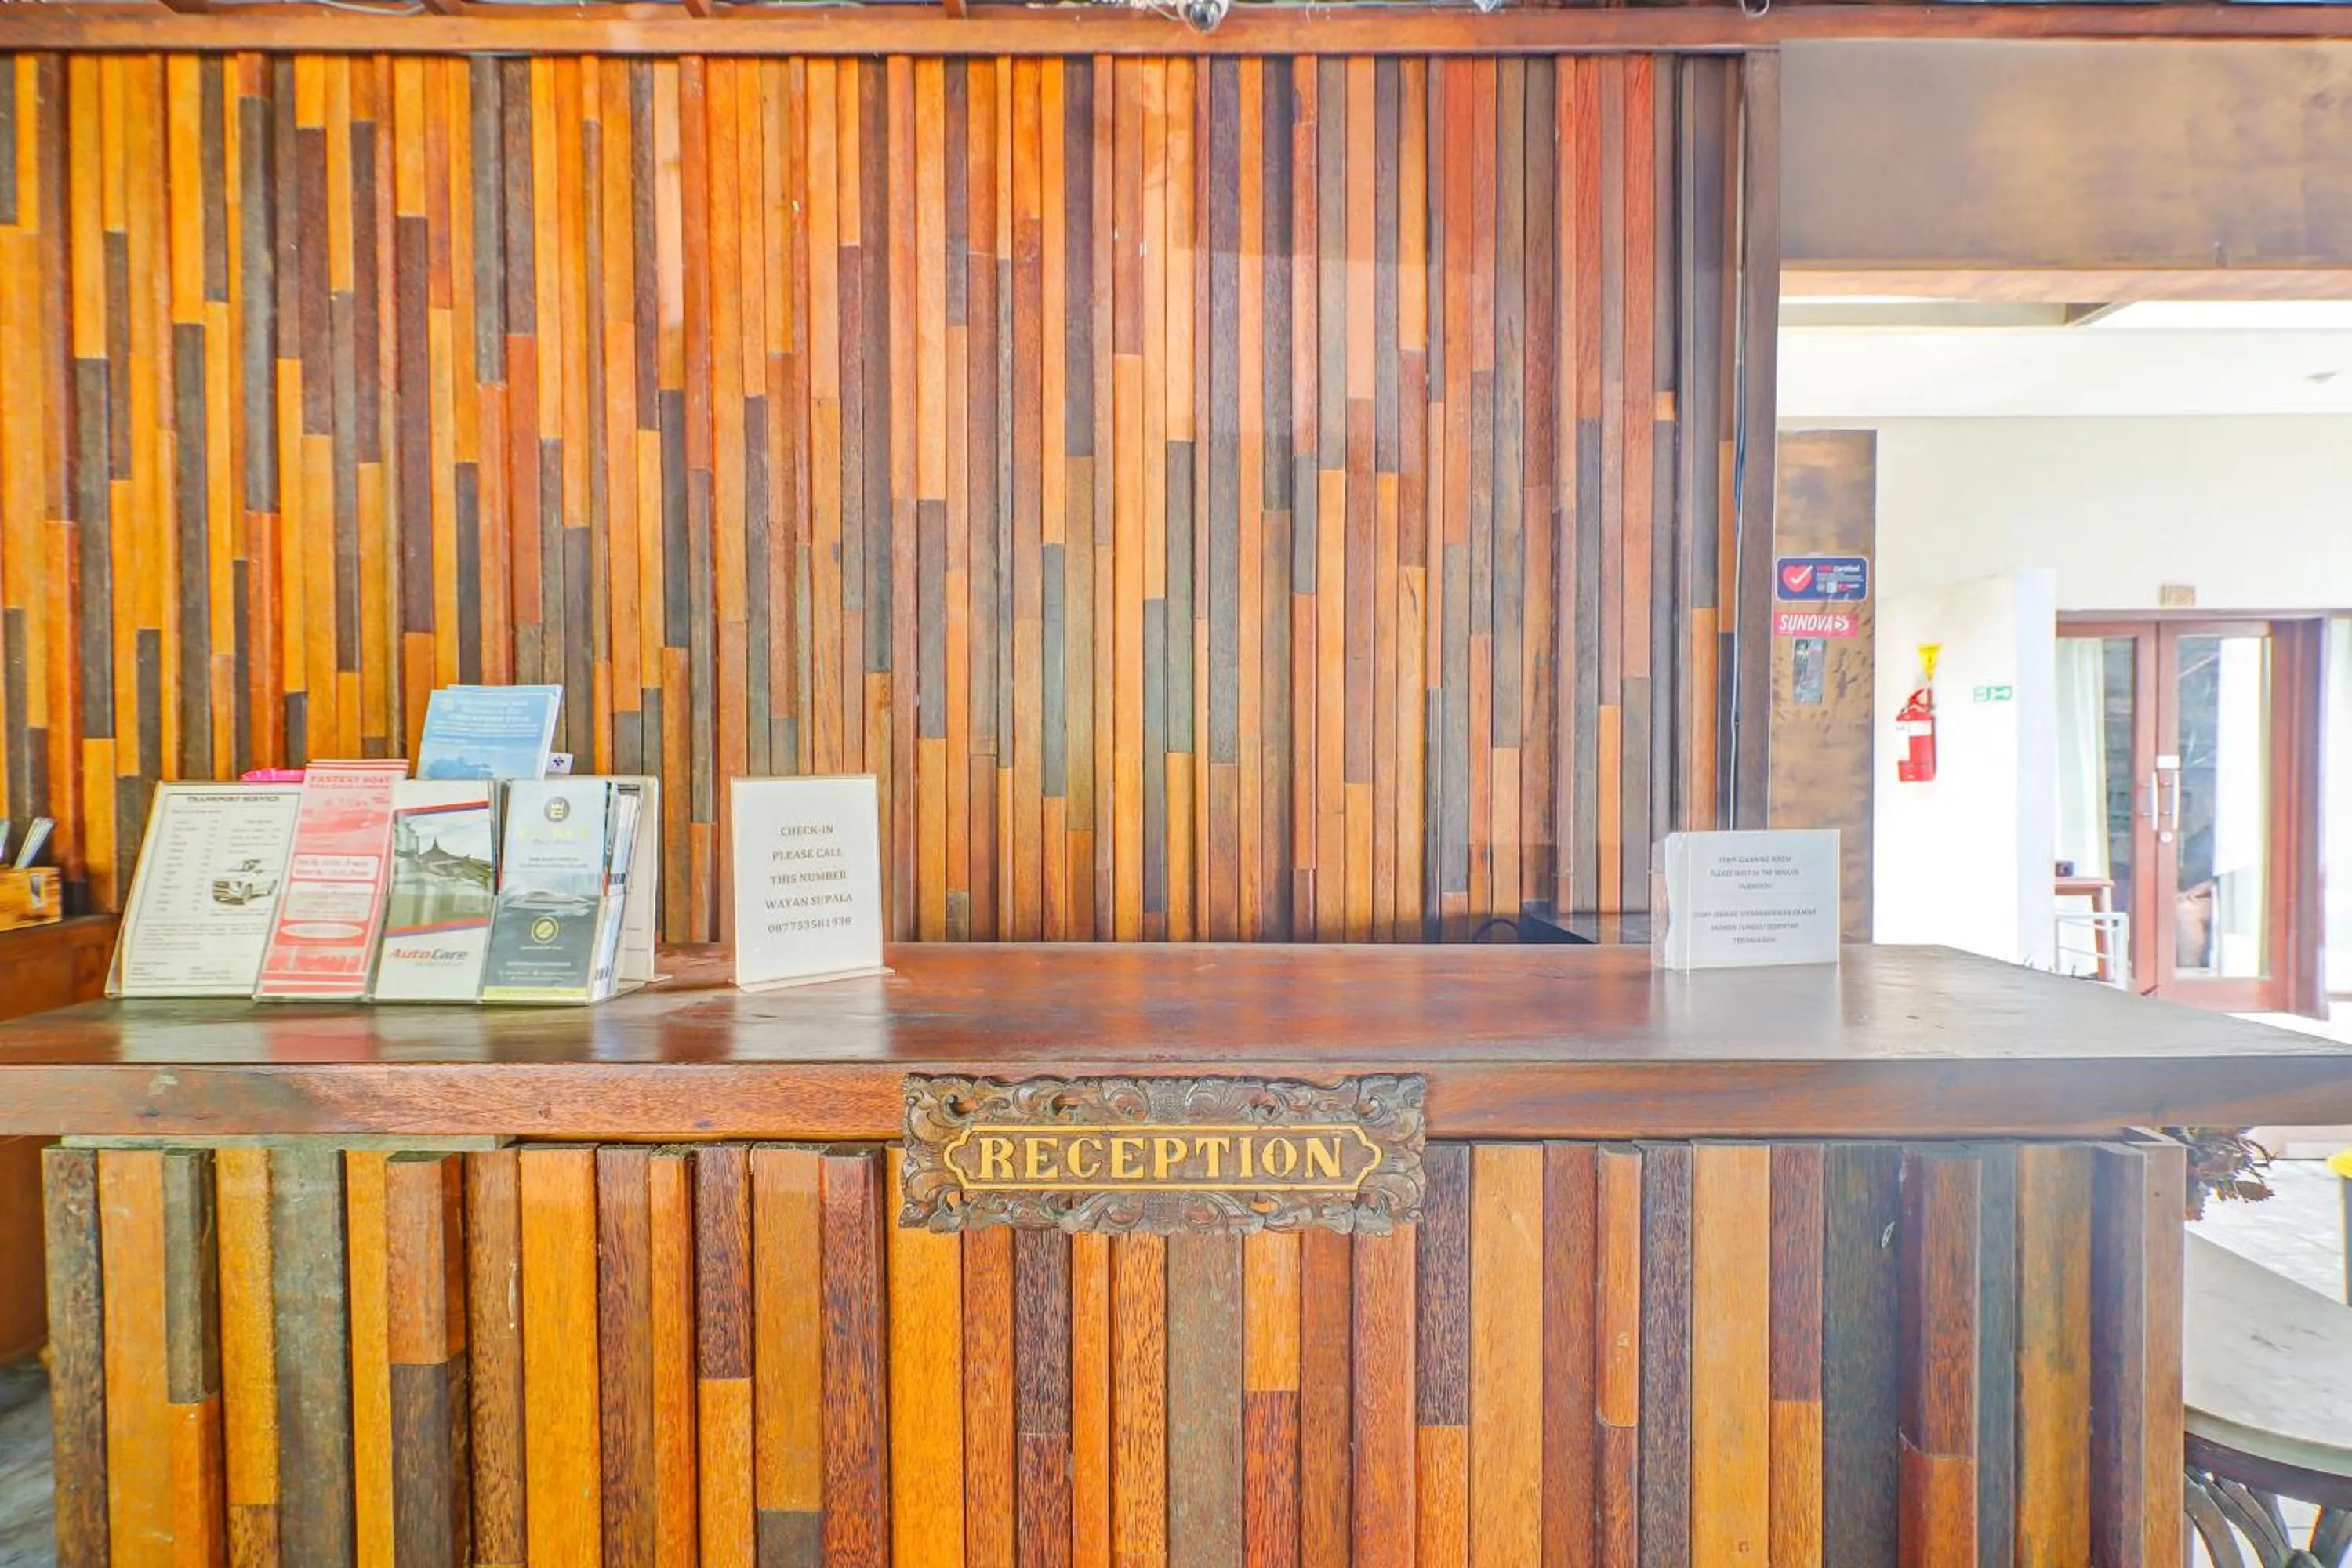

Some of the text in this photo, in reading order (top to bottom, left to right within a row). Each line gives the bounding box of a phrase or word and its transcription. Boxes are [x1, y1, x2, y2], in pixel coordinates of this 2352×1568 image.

[1780, 614, 1833, 632] SUNOVA
[779, 825, 833, 837] CHECK-IN
[771, 848, 844, 862] PLEASE CALL
[770, 870, 847, 885] THIS NUMBER
[765, 893, 853, 909] WAYAN SUPALA
[391, 947, 469, 961] AutoCare
[978, 1137, 1344, 1180] RECEPTION
